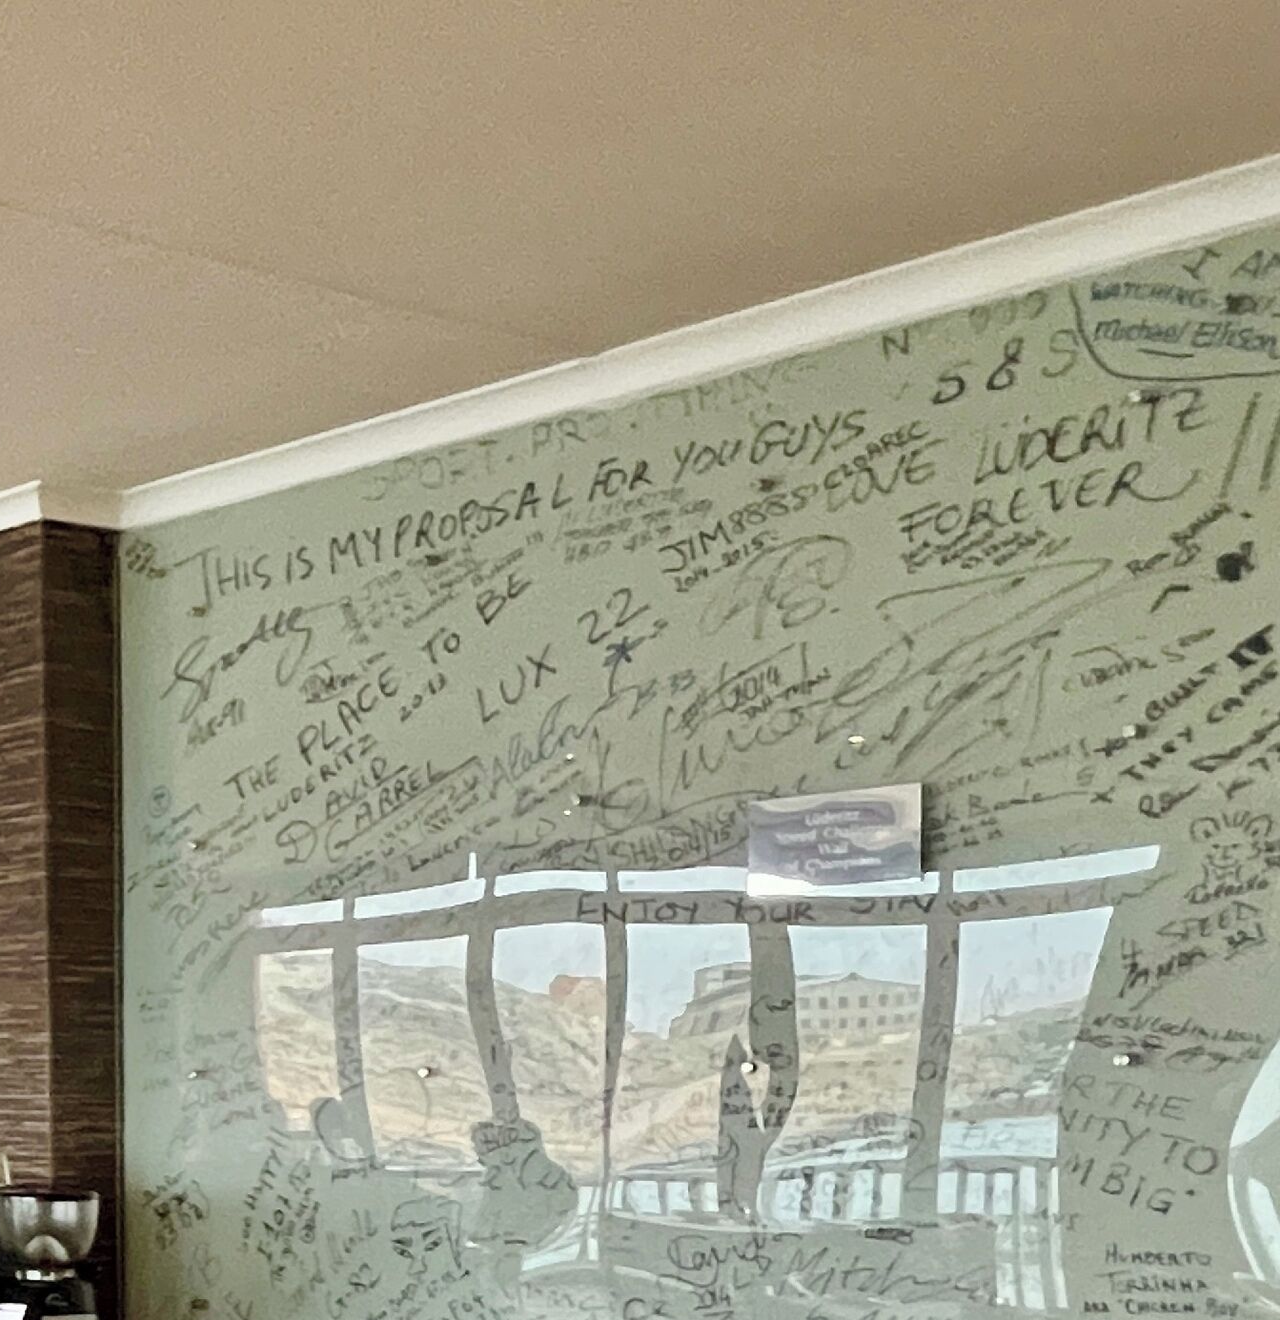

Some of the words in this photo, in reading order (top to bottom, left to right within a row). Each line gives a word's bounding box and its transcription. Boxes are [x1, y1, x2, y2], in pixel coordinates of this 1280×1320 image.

[174, 546, 271, 611] THIS
[286, 545, 315, 585] IS
[329, 527, 383, 576] MY
[589, 457, 653, 502] FOR
[673, 439, 742, 485] YOU
[749, 409, 867, 466] GUYS
[826, 437, 945, 513] LOVE
[897, 460, 1199, 542] FOREVER
[223, 754, 280, 799] THE
[297, 666, 398, 767] PLACE
[420, 626, 461, 667] TO
[475, 572, 532, 626] BE
[476, 644, 557, 724] LUX
[576, 893, 699, 925] ENJOY
[723, 898, 817, 923] YOUR
[1105, 1081, 1192, 1121] THE
[1160, 1132, 1219, 1175] TO
